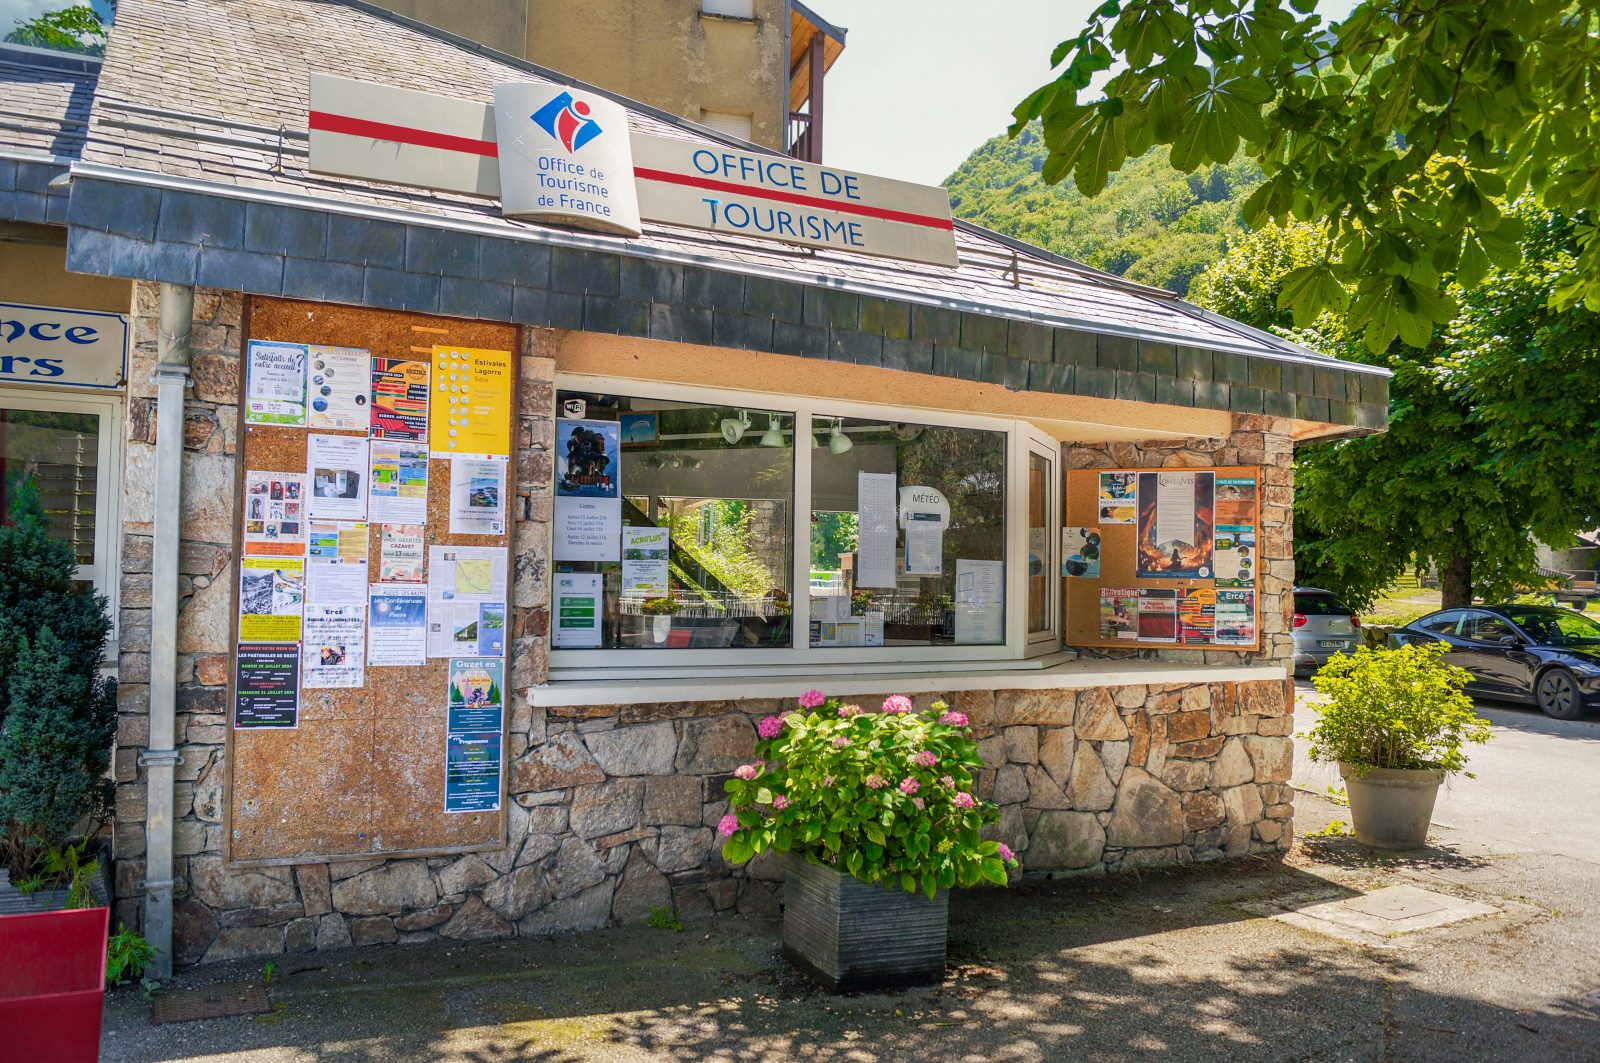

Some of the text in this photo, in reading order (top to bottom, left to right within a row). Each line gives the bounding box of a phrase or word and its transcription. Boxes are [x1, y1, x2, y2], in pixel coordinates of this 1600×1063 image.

[538, 156, 604, 180] Office de
[692, 149, 861, 200] OFFICE DE
[537, 173, 608, 198] Tourisme
[538, 194, 611, 217] de France
[702, 199, 866, 247] TOURISME
[0, 356, 64, 376] rs
[256, 352, 286, 363] Satisfaits
[474, 358, 506, 368] Estivales
[912, 492, 940, 504] MÉTÉO
[630, 534, 661, 545] ACRO'LUS
